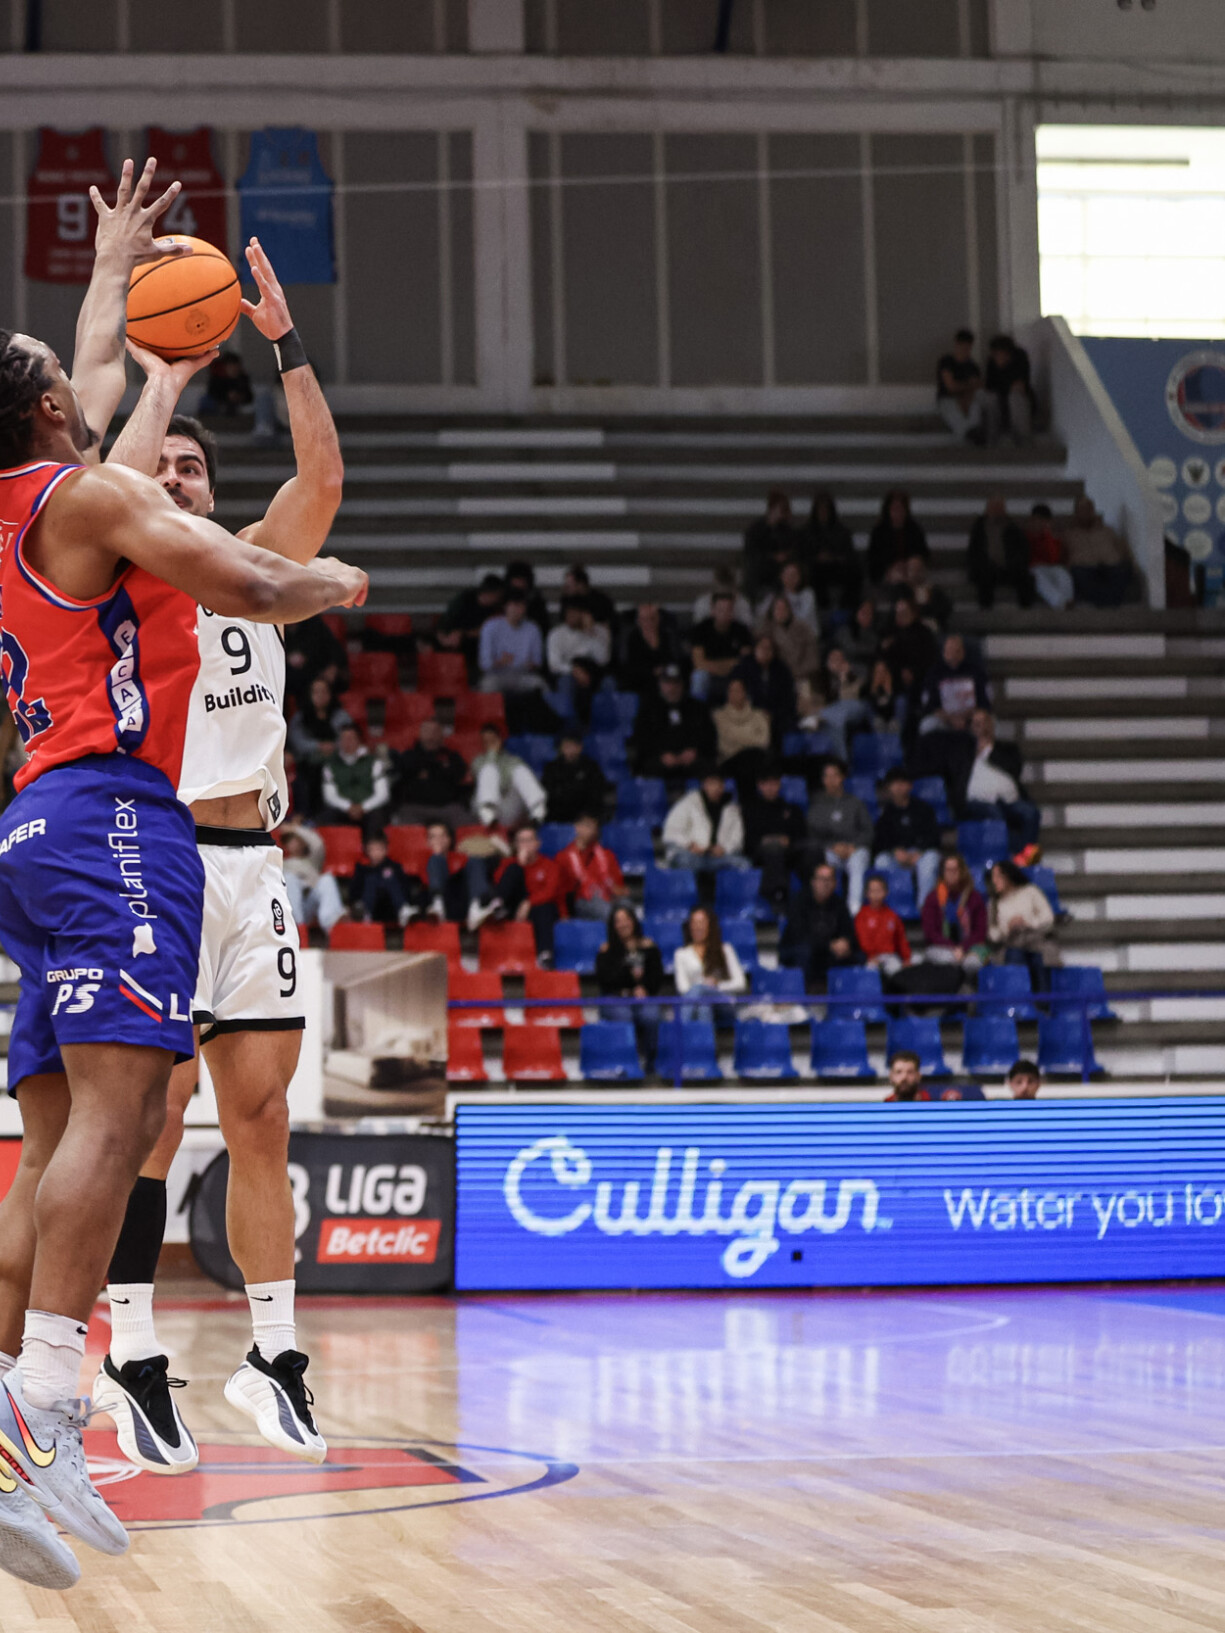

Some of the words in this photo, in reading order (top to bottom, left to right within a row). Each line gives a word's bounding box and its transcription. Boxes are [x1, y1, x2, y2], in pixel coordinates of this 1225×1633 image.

[56, 194, 88, 240] 9
[221, 626, 252, 675] 9
[108, 797, 157, 919] planiflex
[47, 968, 104, 983] GRUPO
[277, 947, 296, 998] 9
[51, 983, 101, 1016] PS
[503, 1137, 879, 1278] Culligan
[943, 1188, 1081, 1231] Water
[1092, 1190, 1173, 1240] you
[1186, 1183, 1225, 1226] lo
[326, 1226, 429, 1256] Betclic
